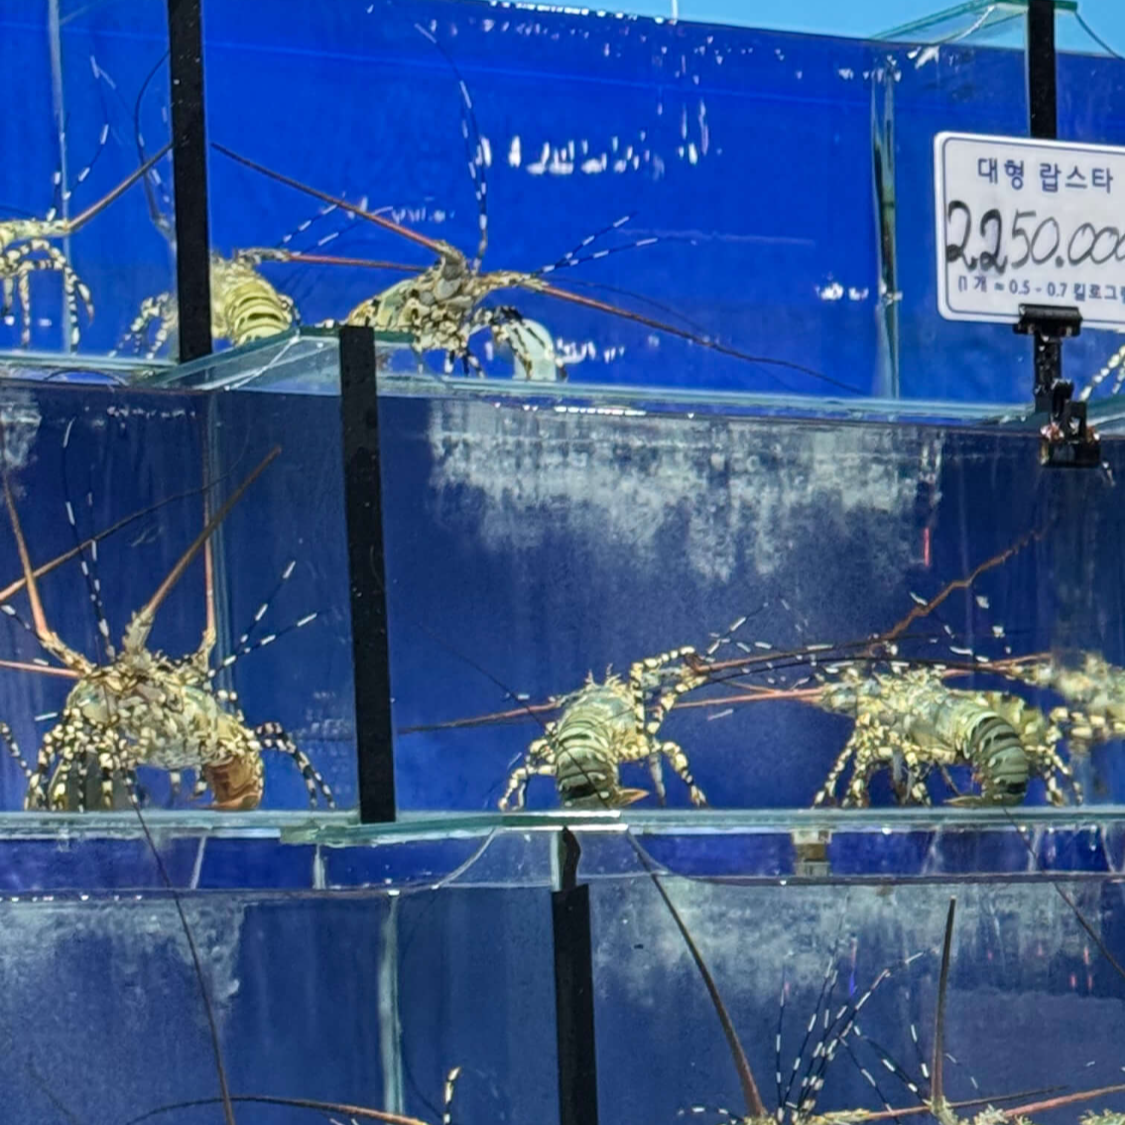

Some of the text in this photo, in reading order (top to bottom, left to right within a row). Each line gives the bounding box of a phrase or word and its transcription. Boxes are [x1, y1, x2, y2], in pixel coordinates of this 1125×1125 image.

[977, 157, 1114, 193] 대형 랍스타
[1009, 279, 1030, 295] 0.5
[1047, 282, 1068, 298] 0.7
